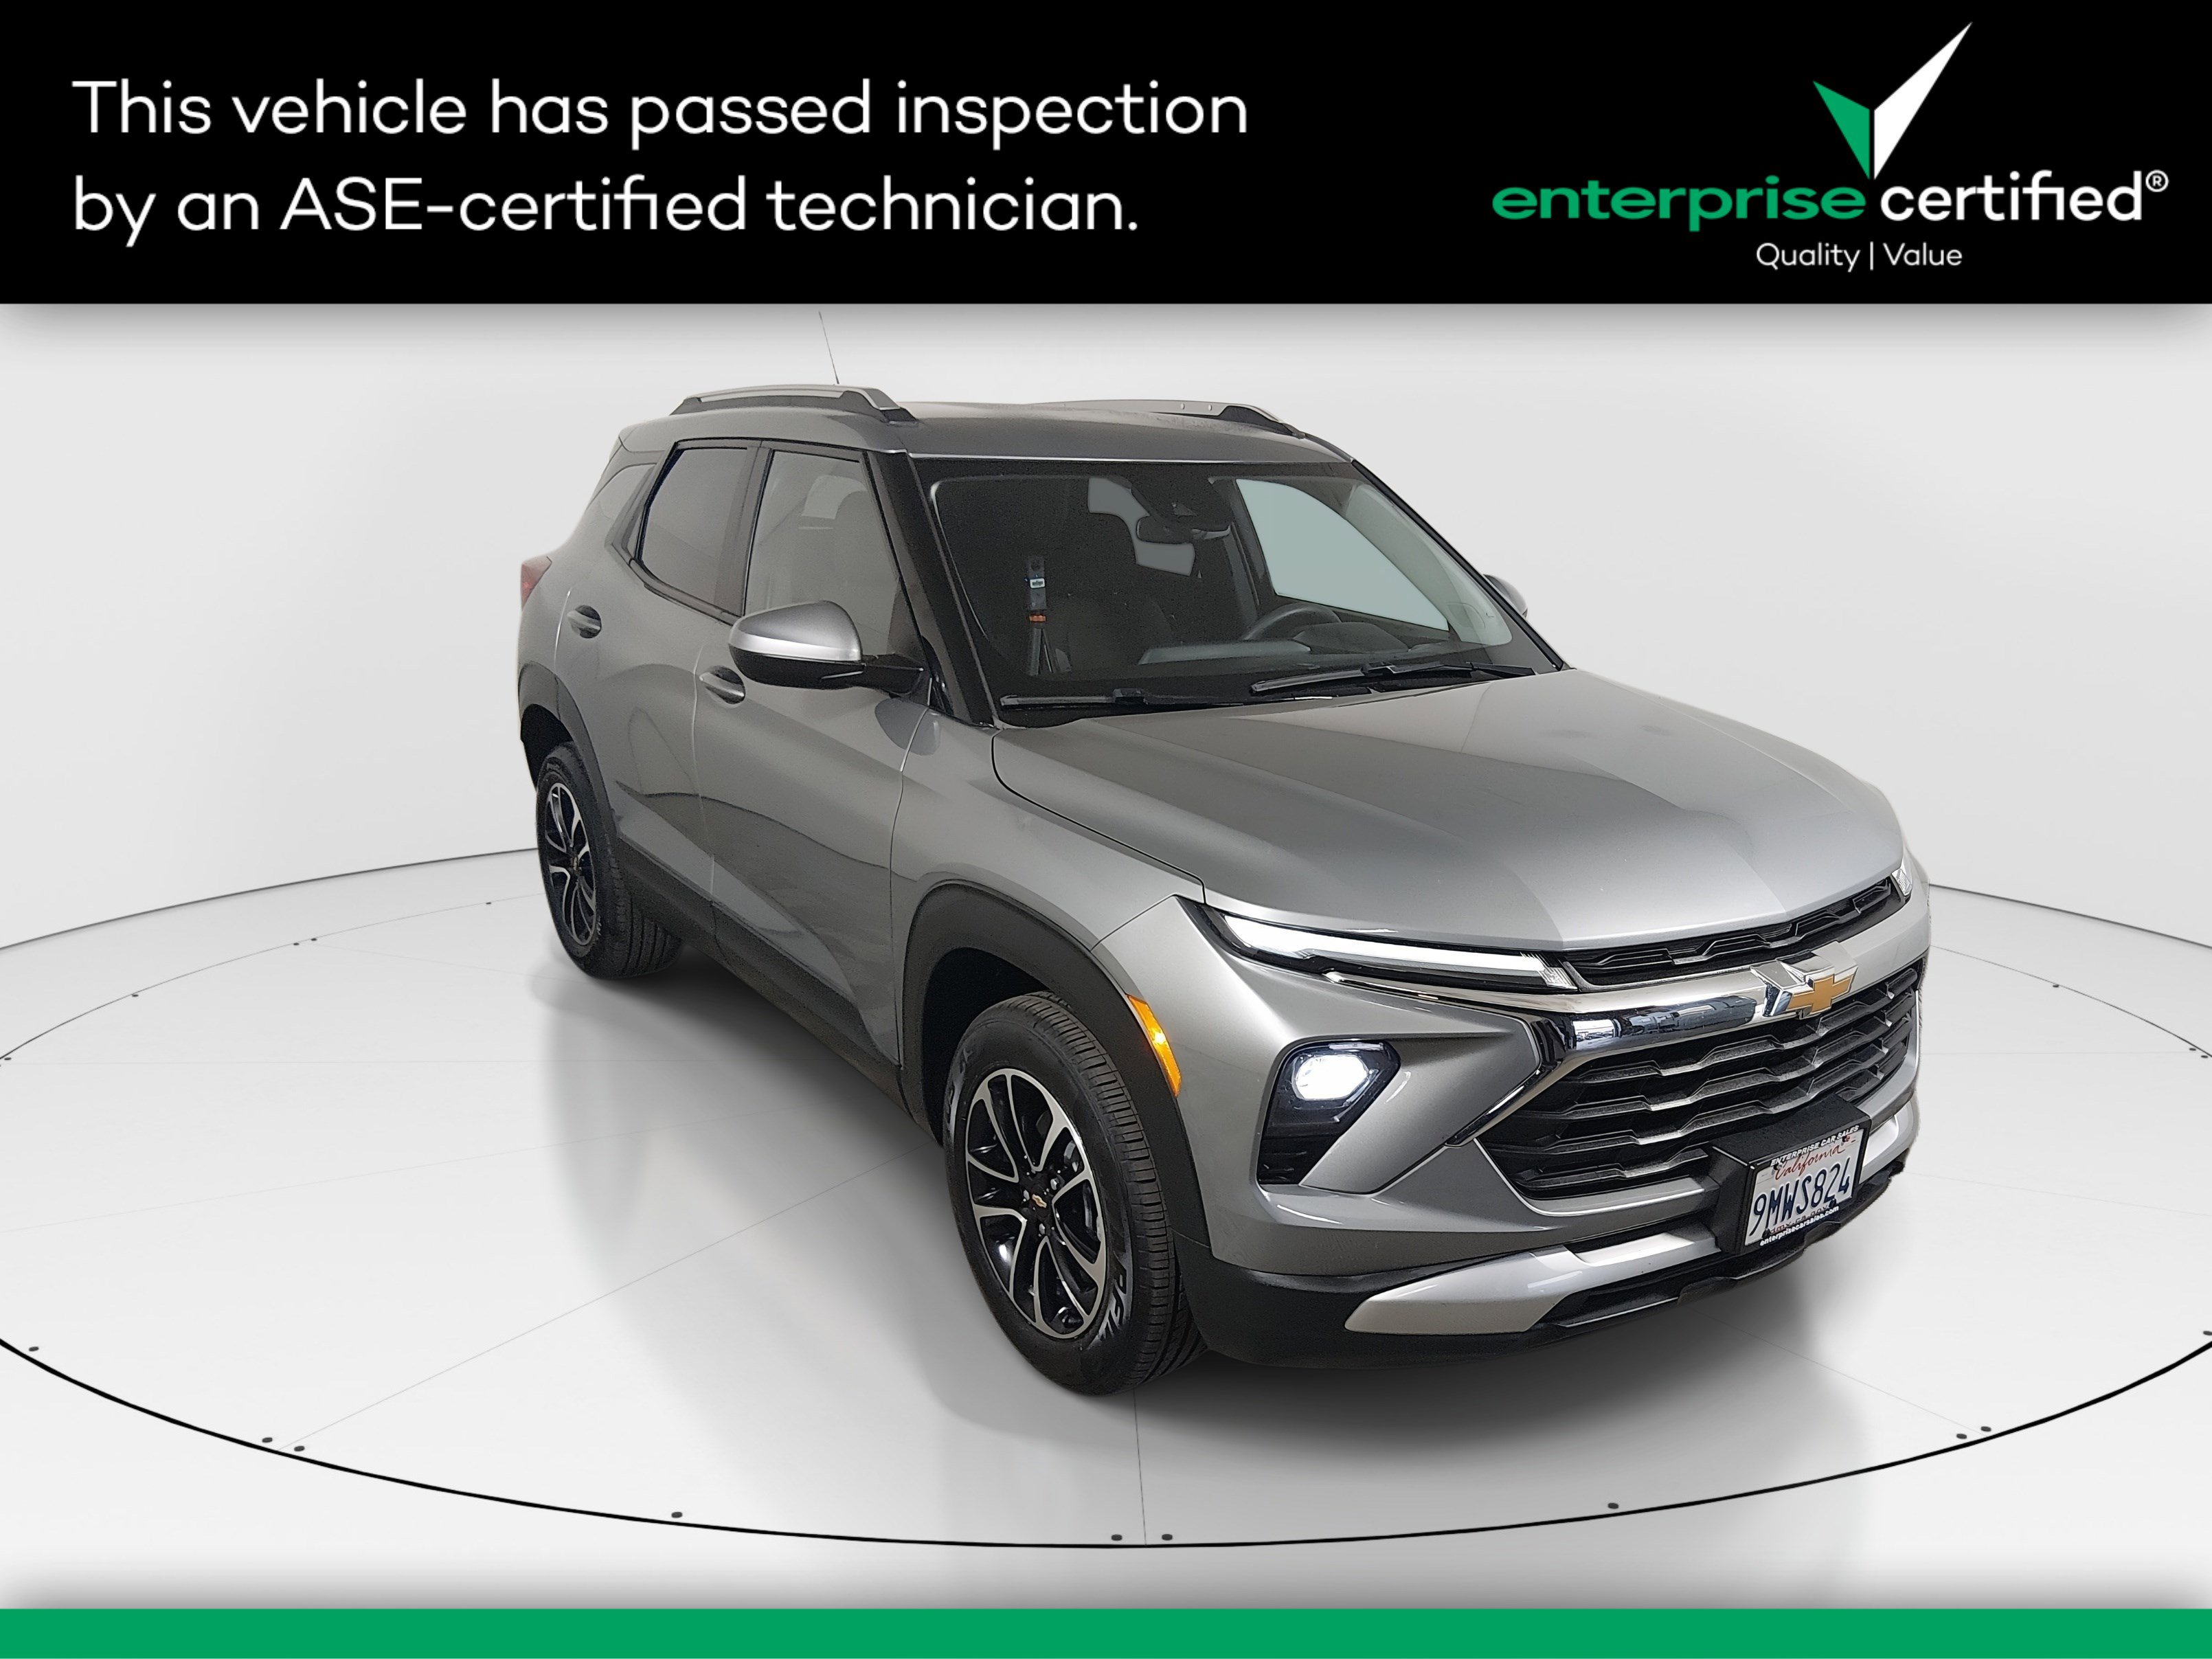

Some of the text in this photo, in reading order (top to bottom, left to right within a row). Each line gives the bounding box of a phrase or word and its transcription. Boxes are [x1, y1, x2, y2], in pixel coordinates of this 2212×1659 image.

[1770, 1125, 1860, 1166] ENTERPRISE CAR SALES
[1775, 1143, 1845, 1180] California
[1749, 1158, 1850, 1237] 9MWS824
[1760, 1206, 1840, 1246] enterprisecarsales.com
